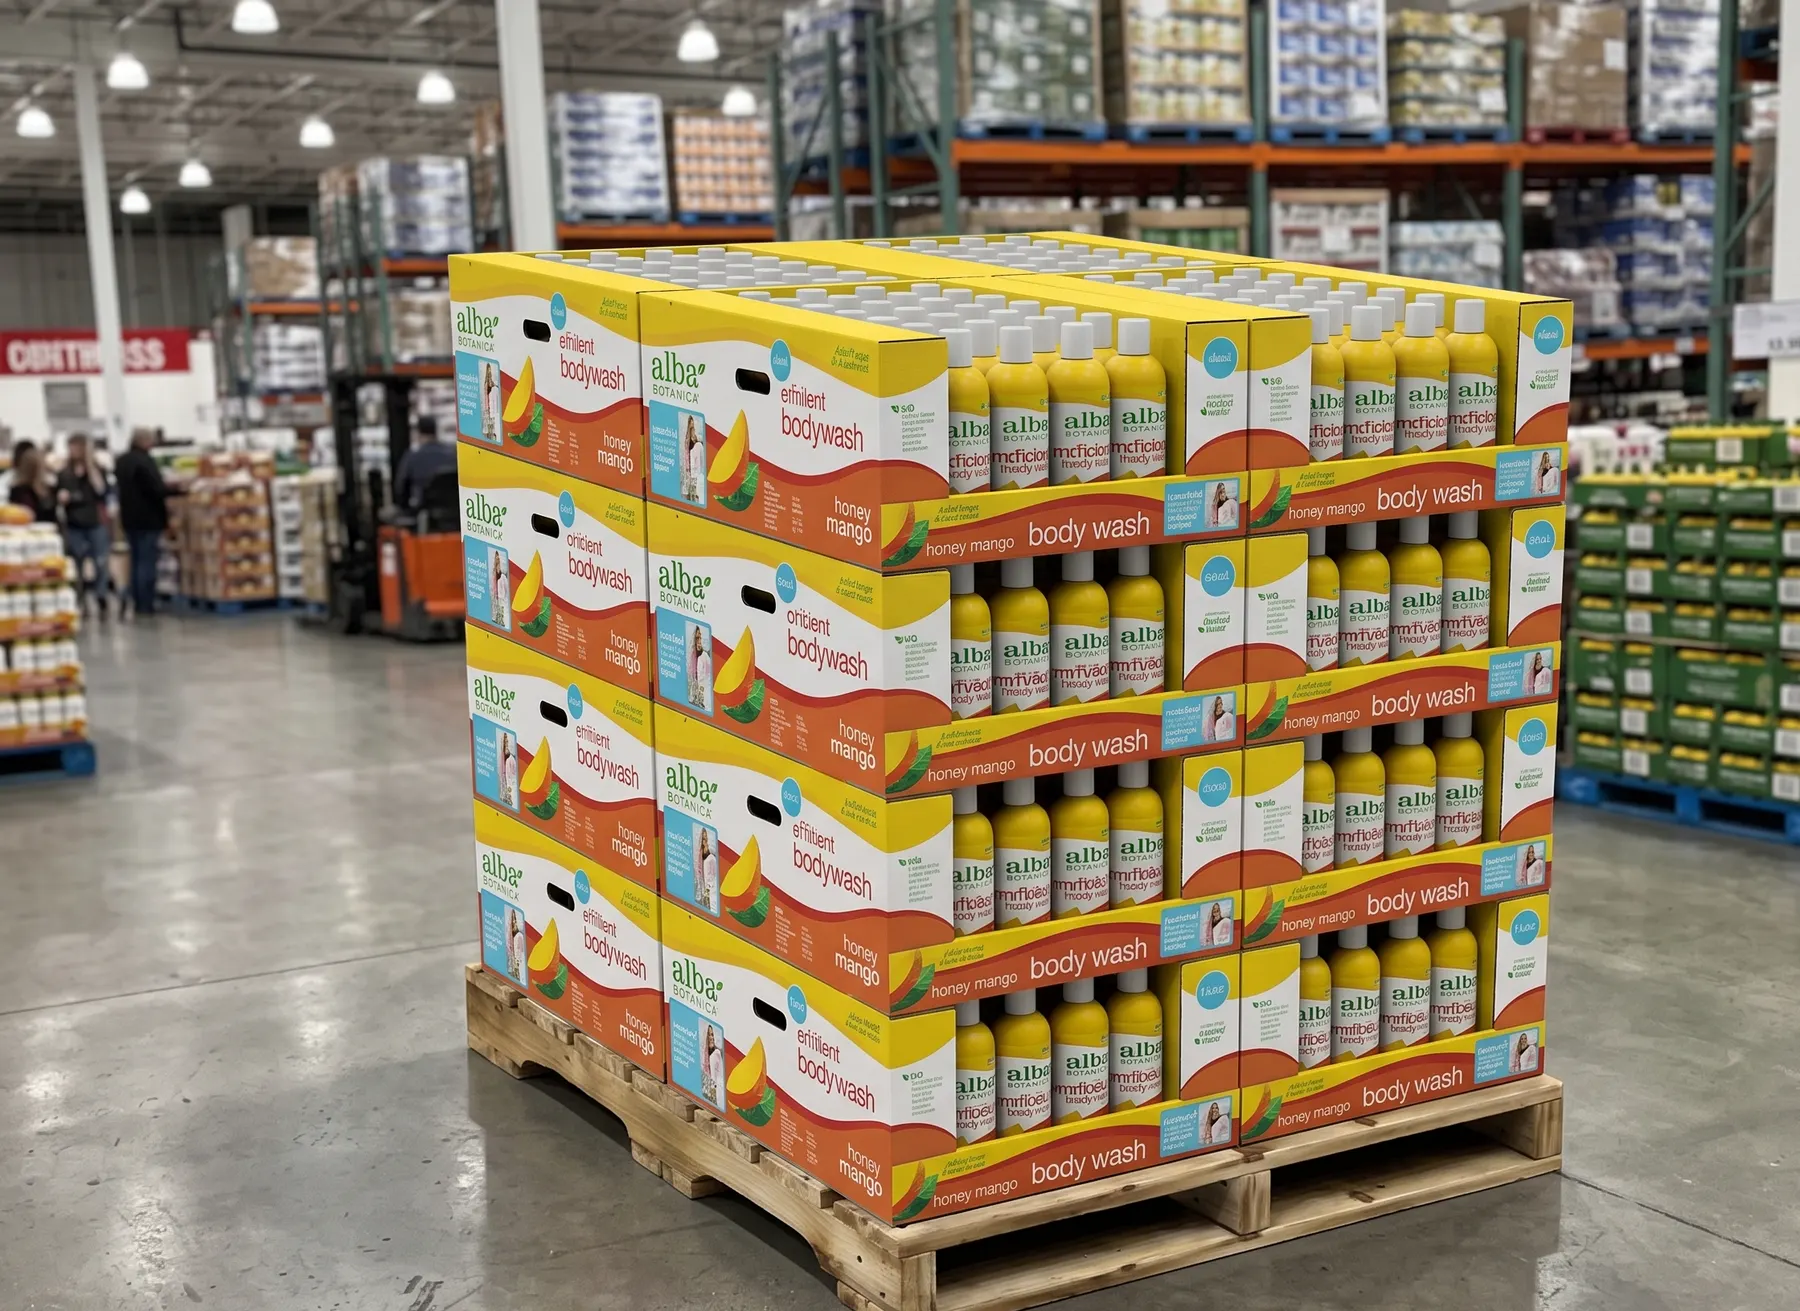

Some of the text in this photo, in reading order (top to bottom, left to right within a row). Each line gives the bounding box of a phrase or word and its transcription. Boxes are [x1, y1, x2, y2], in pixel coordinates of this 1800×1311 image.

[457, 306, 496, 338] alba
[560, 354, 625, 391] bodywash
[652, 351, 702, 389] alba
[604, 431, 631, 456] honey
[781, 408, 864, 452] bodywash
[598, 450, 633, 475] mango
[466, 493, 506, 527] alba
[834, 495, 871, 526] honey
[1289, 506, 1323, 521] honey
[1326, 503, 1365, 519] mango
[1377, 484, 1427, 513] body
[1433, 478, 1483, 505] wash
[826, 516, 872, 547] mango
[926, 511, 1150, 557] honey mango body wash
[568, 551, 633, 594] bodywash
[658, 560, 708, 600] alba
[605, 647, 640, 675] mango
[610, 629, 639, 657] honey
[787, 628, 868, 681] bodywash
[474, 675, 514, 711] alba
[1284, 681, 1475, 730] honey mango body wash
[839, 718, 875, 748] honey
[577, 741, 639, 790] bodywash
[831, 737, 876, 770] mango
[928, 729, 1148, 783] honey mango body wash
[666, 763, 714, 805] alba
[612, 837, 648, 867] mango
[618, 821, 645, 848] honey
[482, 851, 521, 889] alba
[793, 842, 872, 901] bodywash
[1282, 877, 1469, 932] honey mango body wash
[584, 926, 647, 981] bodywash
[835, 952, 880, 987] mango
[843, 934, 878, 968] honey
[931, 937, 1147, 998] honey mango body wash
[672, 957, 719, 1002] alba
[620, 1025, 654, 1056] mango
[625, 1008, 652, 1038] honey
[798, 1047, 875, 1113] bodywash
[1278, 1065, 1463, 1127] honey mango body wash
[839, 1159, 883, 1197] mango
[847, 1142, 881, 1178] honey
[933, 1139, 1146, 1207] honey mango body wash
